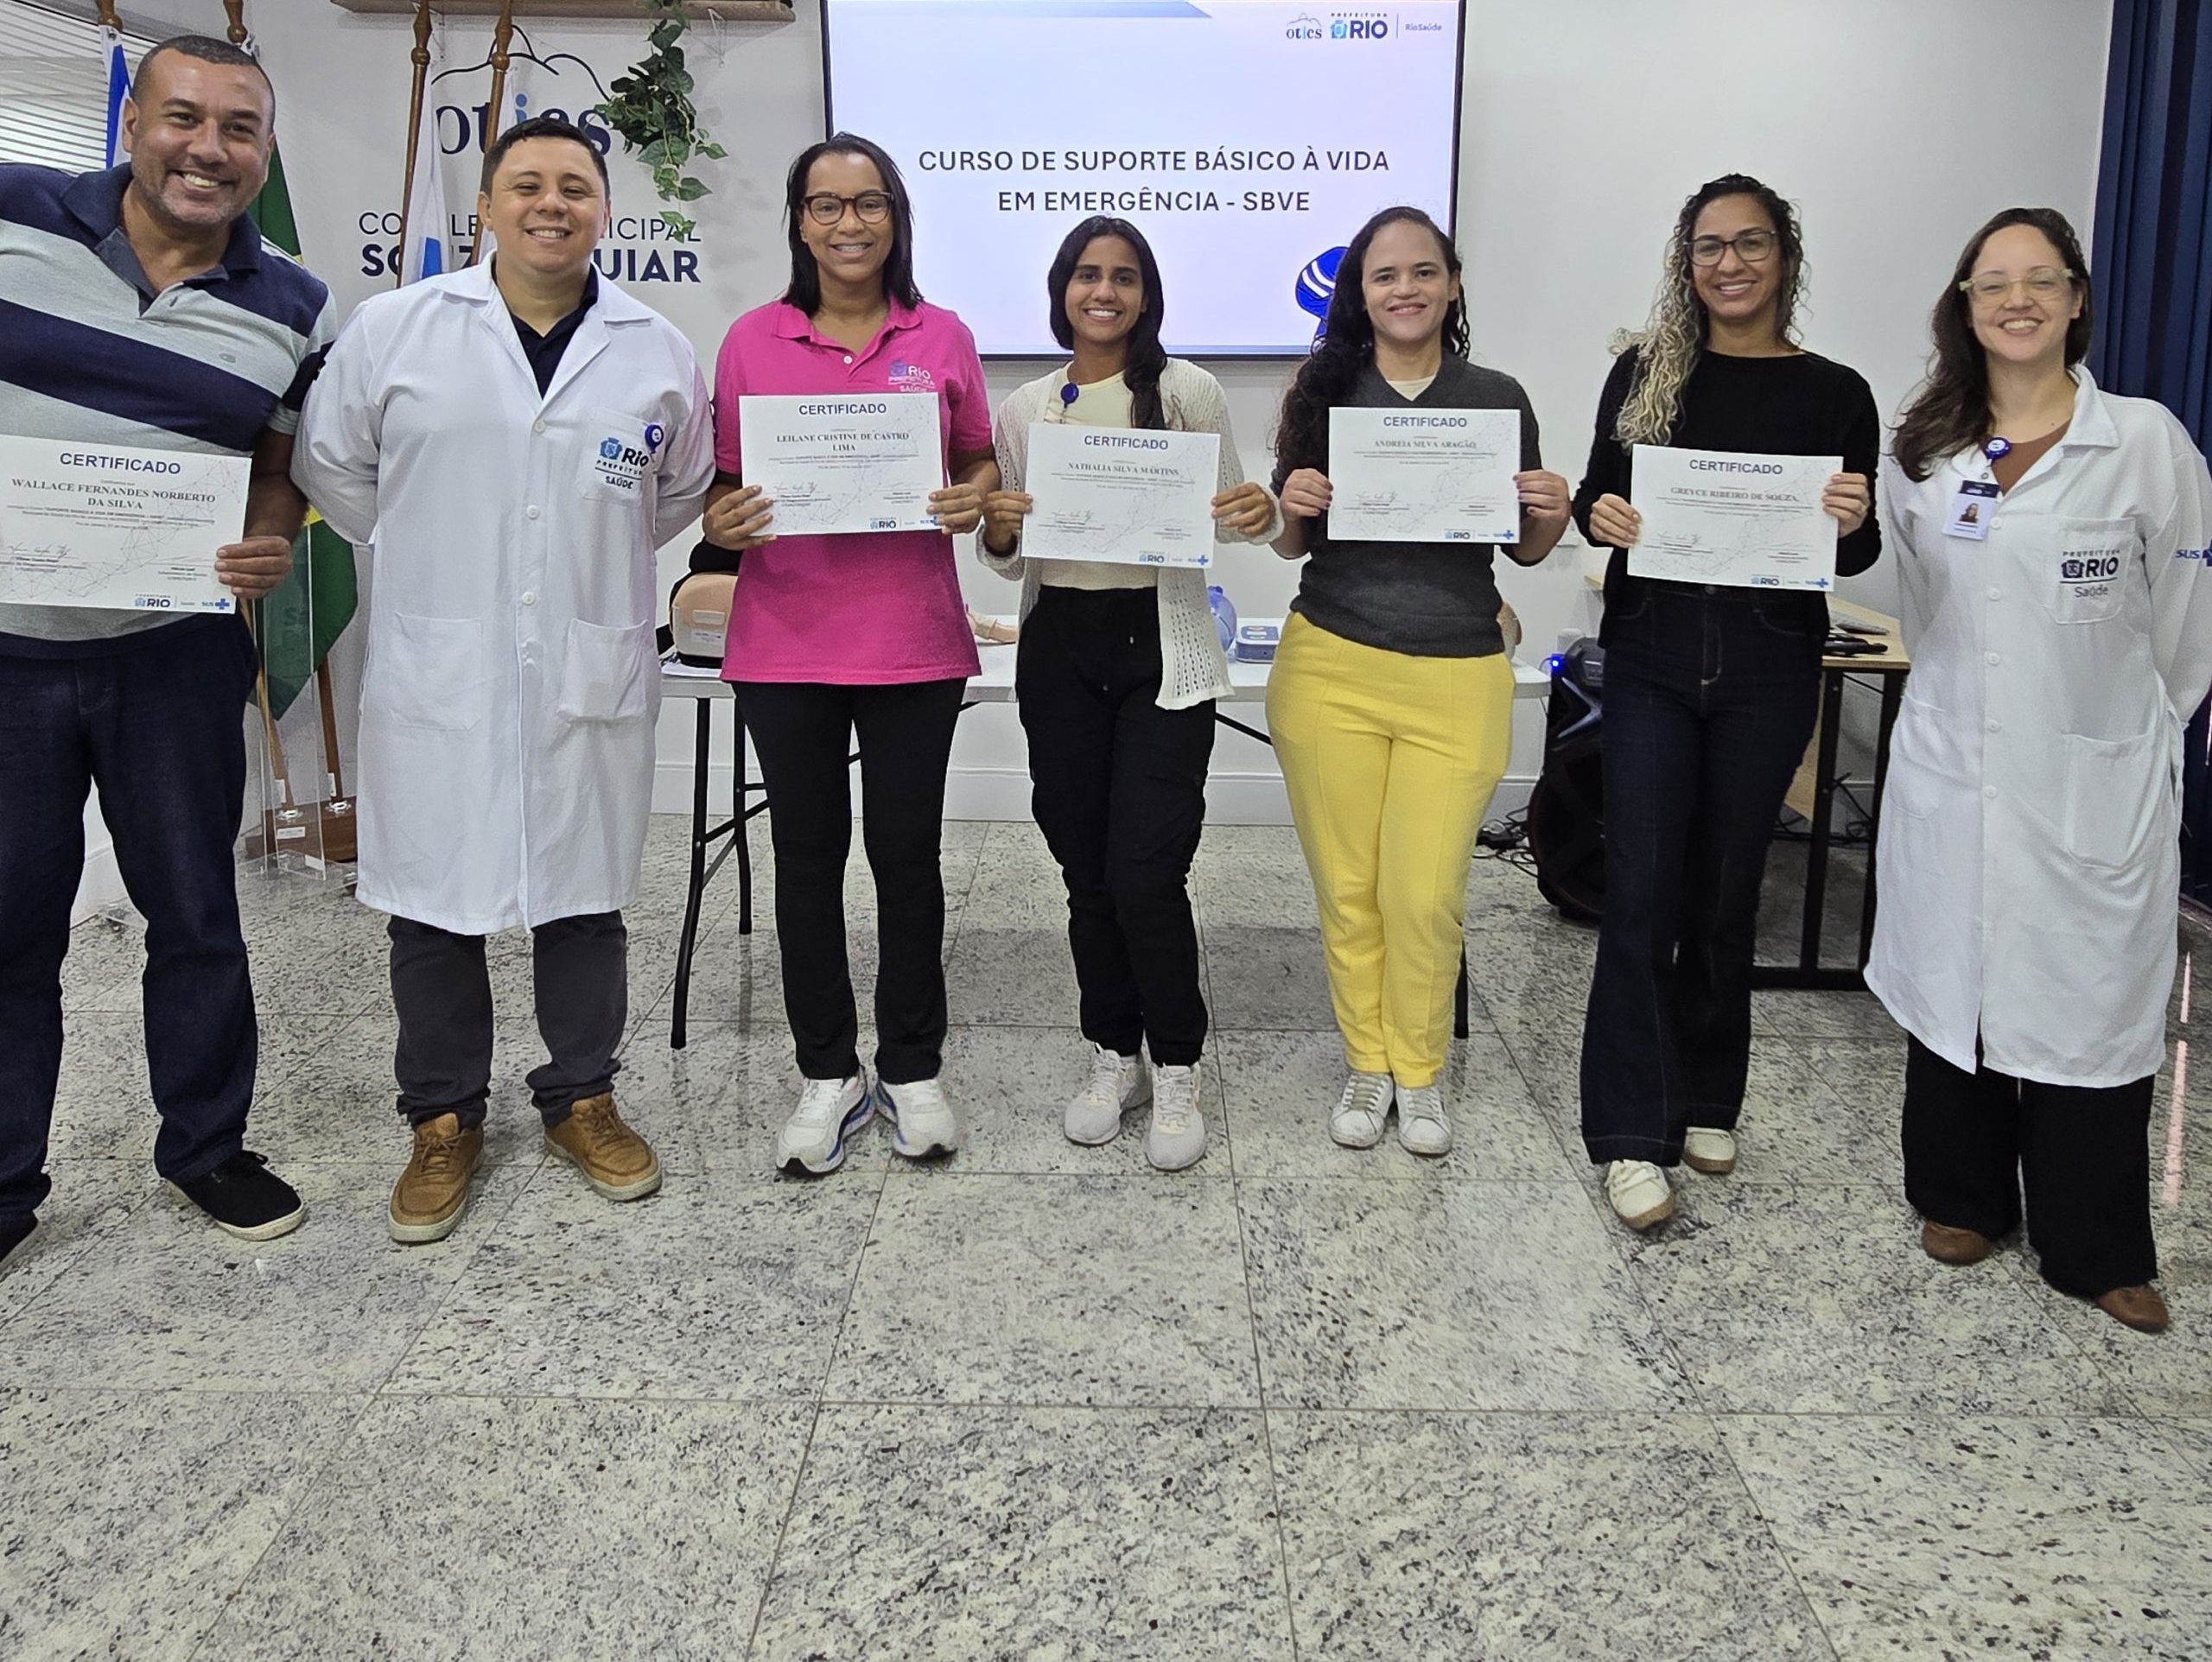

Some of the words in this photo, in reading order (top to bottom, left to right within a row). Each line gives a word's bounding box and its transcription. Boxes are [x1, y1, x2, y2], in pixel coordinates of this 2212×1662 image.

[1286, 26, 1322, 39] otics
[1350, 20, 1388, 39] RIO
[918, 150, 1014, 171] CURSO
[1022, 150, 1057, 171] DE
[1064, 150, 1186, 171] SUPORTE
[1195, 144, 1294, 171] BÁSICO
[1303, 143, 1319, 171] À
[1327, 151, 1389, 171] VIDA
[998, 192, 1036, 212] EM
[1045, 187, 1219, 212] EMERGÊNCIA
[1243, 192, 1311, 212] SBVE
[594, 249, 701, 283] UIAR
[798, 403, 887, 415] CERTIFICADO
[1383, 416, 1467, 427] CERTIFICADO
[1084, 435, 1168, 450] CERTIFICADO
[60, 453, 181, 474] CERTIFICADO
[596, 460, 642, 475] PREFEITUR
[1114, 465, 1138, 473] SILVA
[1689, 460, 1783, 474] CERTIFICADO
[12, 479, 74, 492] WALLACE
[78, 485, 149, 498] FERNANDES
[152, 490, 216, 503] NORBERTO
[88, 498, 104, 507] DA
[107, 499, 143, 510] SILVA
[2175, 549, 2200, 559] SUS
[2086, 556, 2119, 577] RIO
[147, 599, 171, 607] RIO
